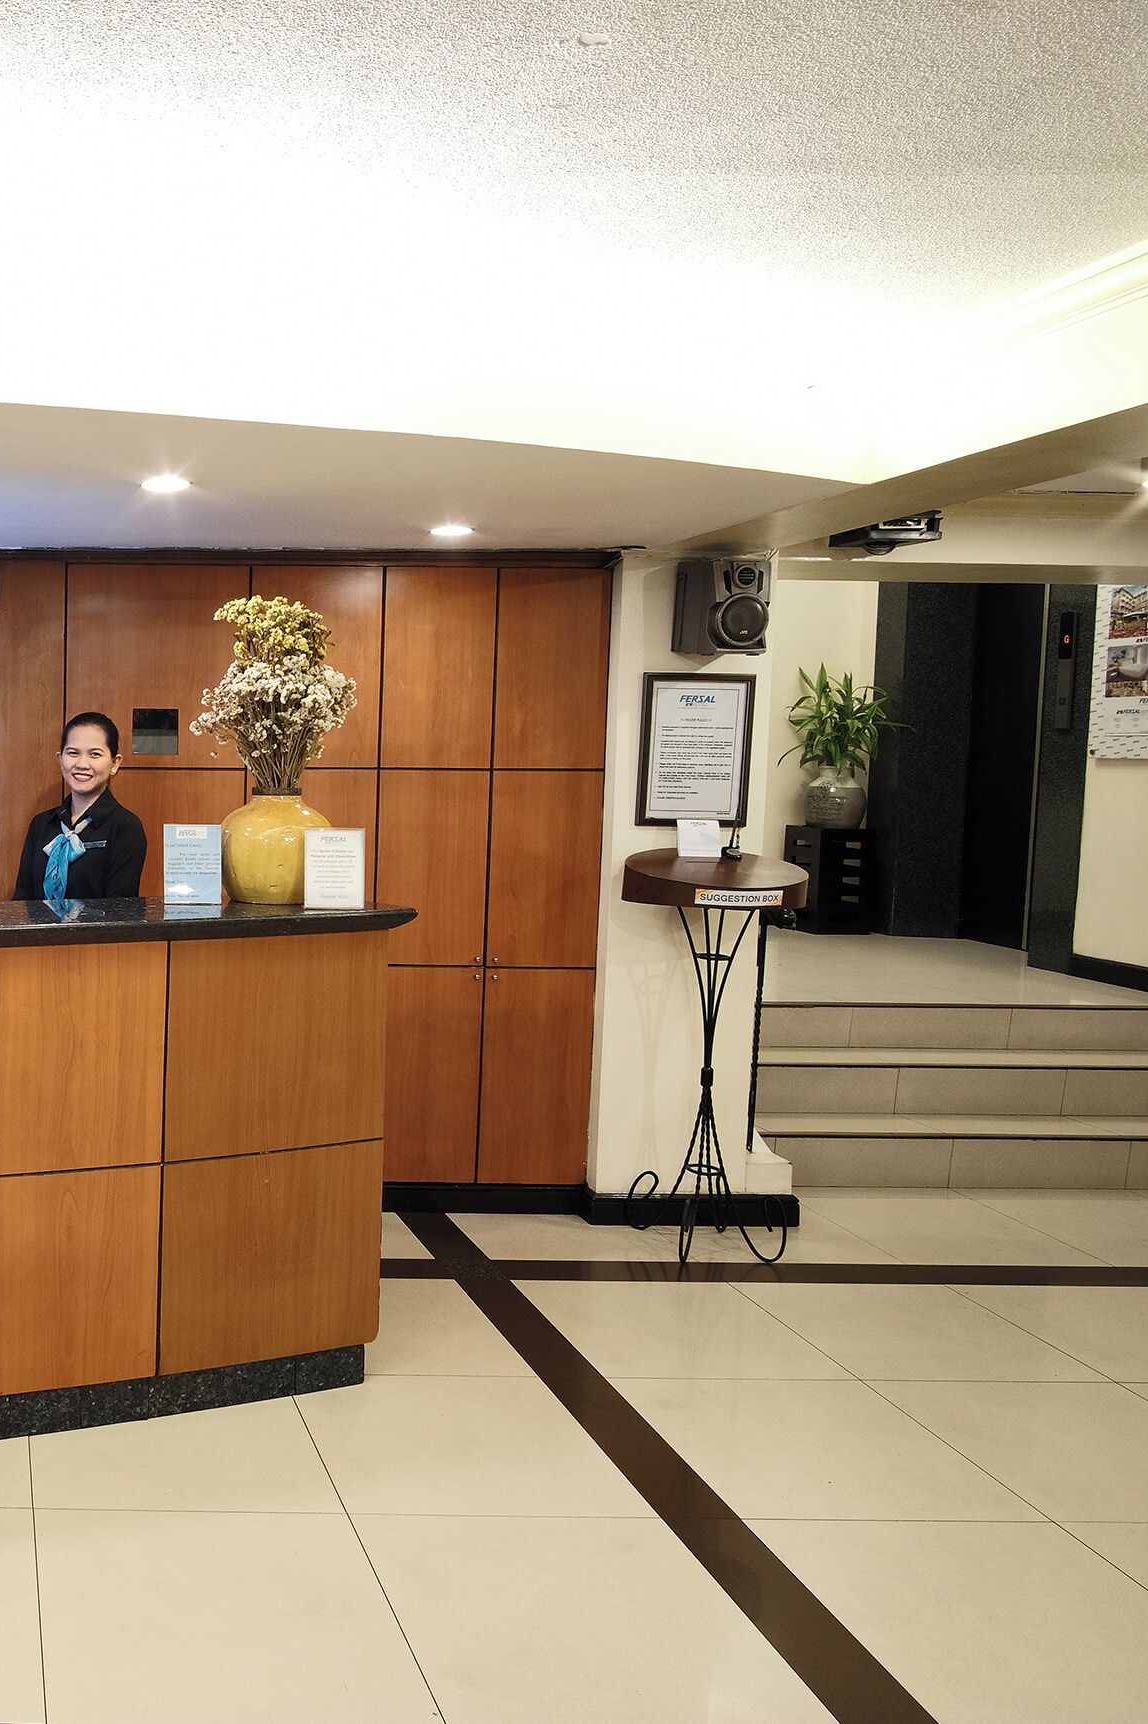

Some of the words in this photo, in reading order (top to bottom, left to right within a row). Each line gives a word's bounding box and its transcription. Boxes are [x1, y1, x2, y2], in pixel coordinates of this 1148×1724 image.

[1063, 635, 1070, 644] G
[679, 695, 716, 703] FERSAL
[700, 893, 761, 903] SUGGESTION
[762, 894, 780, 903] BOX
